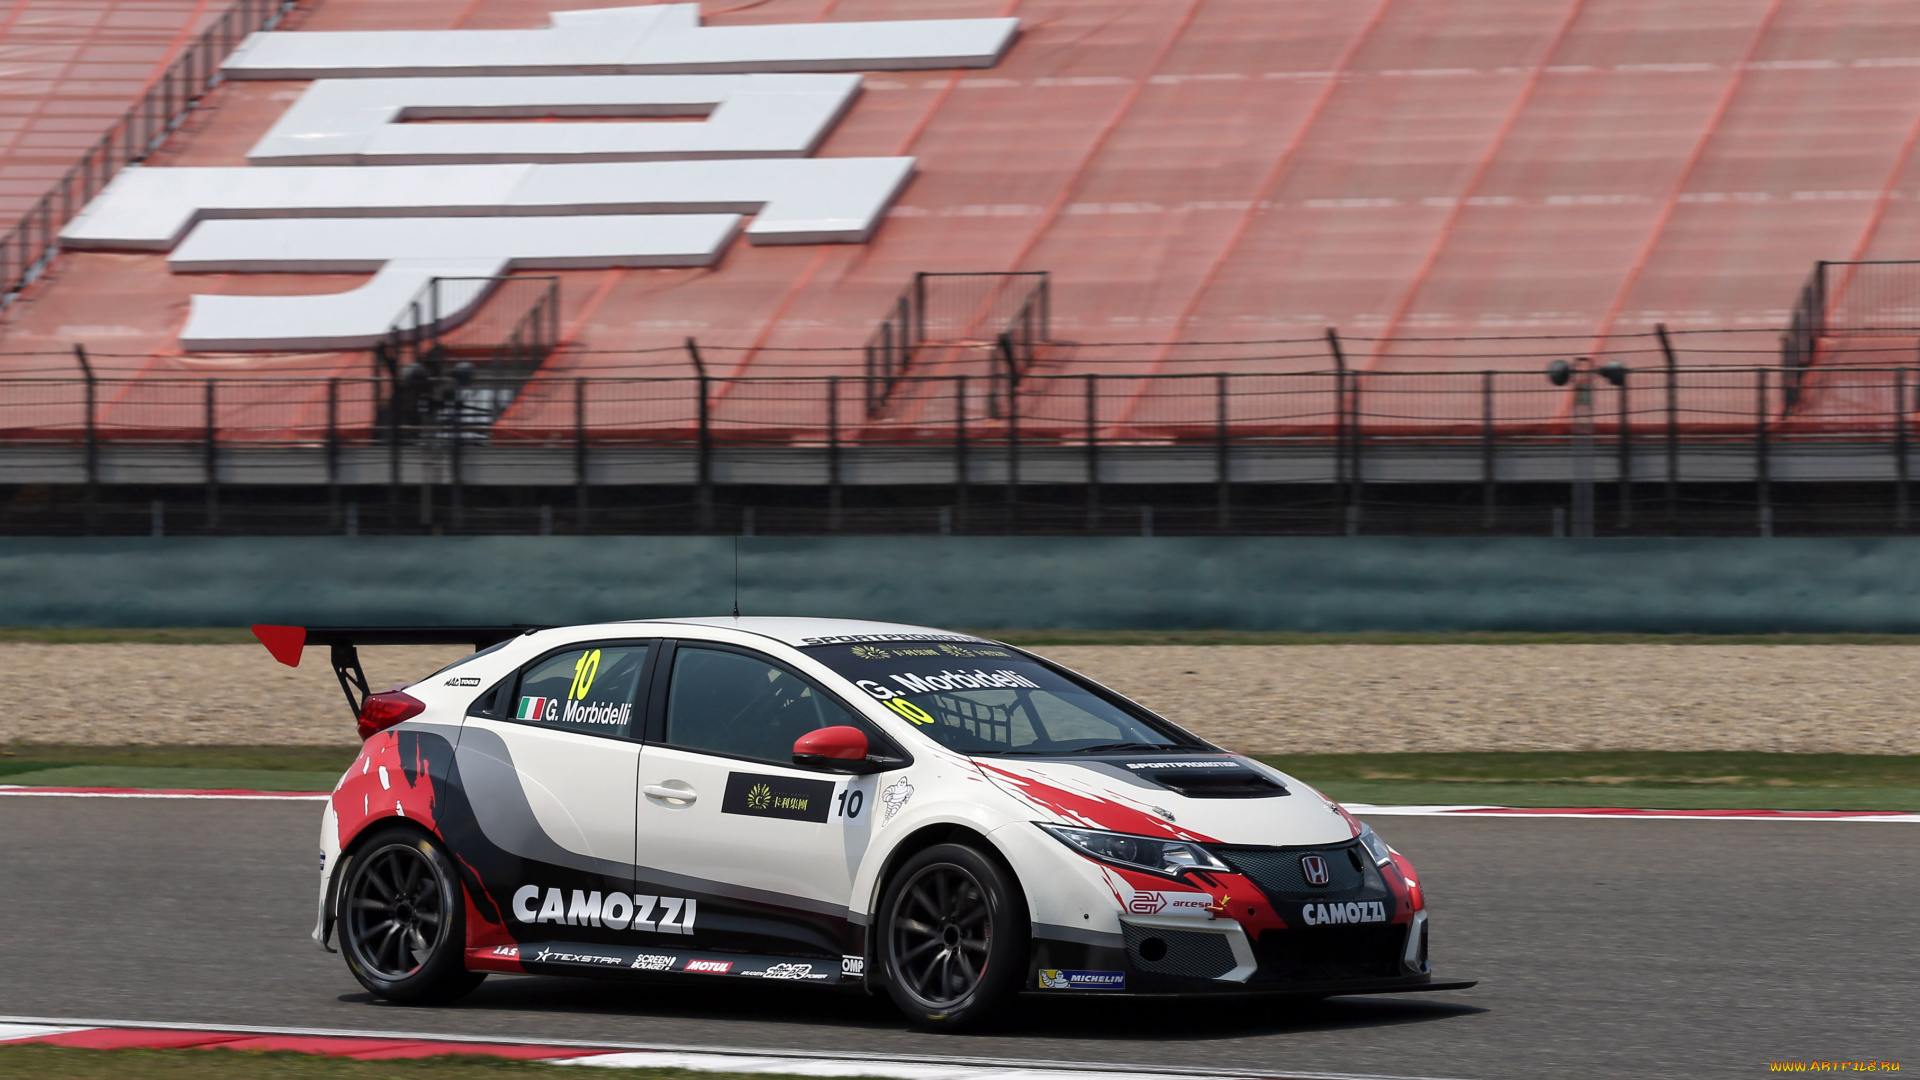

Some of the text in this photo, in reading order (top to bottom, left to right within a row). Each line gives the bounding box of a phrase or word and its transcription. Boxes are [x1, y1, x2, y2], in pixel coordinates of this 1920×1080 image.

[801, 634, 998, 647] SPORTPROMOT
[568, 649, 602, 700] 10
[855, 668, 1041, 700] G. Morbidelli
[545, 699, 632, 726] G. Morbidelli
[882, 697, 935, 725] 10
[1126, 761, 1240, 770] SPORTPROMOTION
[838, 789, 864, 818] 10
[512, 884, 697, 935] CAMOZZI
[1173, 900, 1212, 908] arcese
[1302, 901, 1387, 926] CAMOZZI
[553, 952, 622, 964] TEXSTAR
[686, 960, 729, 972] MOTUL
[842, 958, 864, 973] OMP
[1070, 974, 1124, 984] MICHELIN
